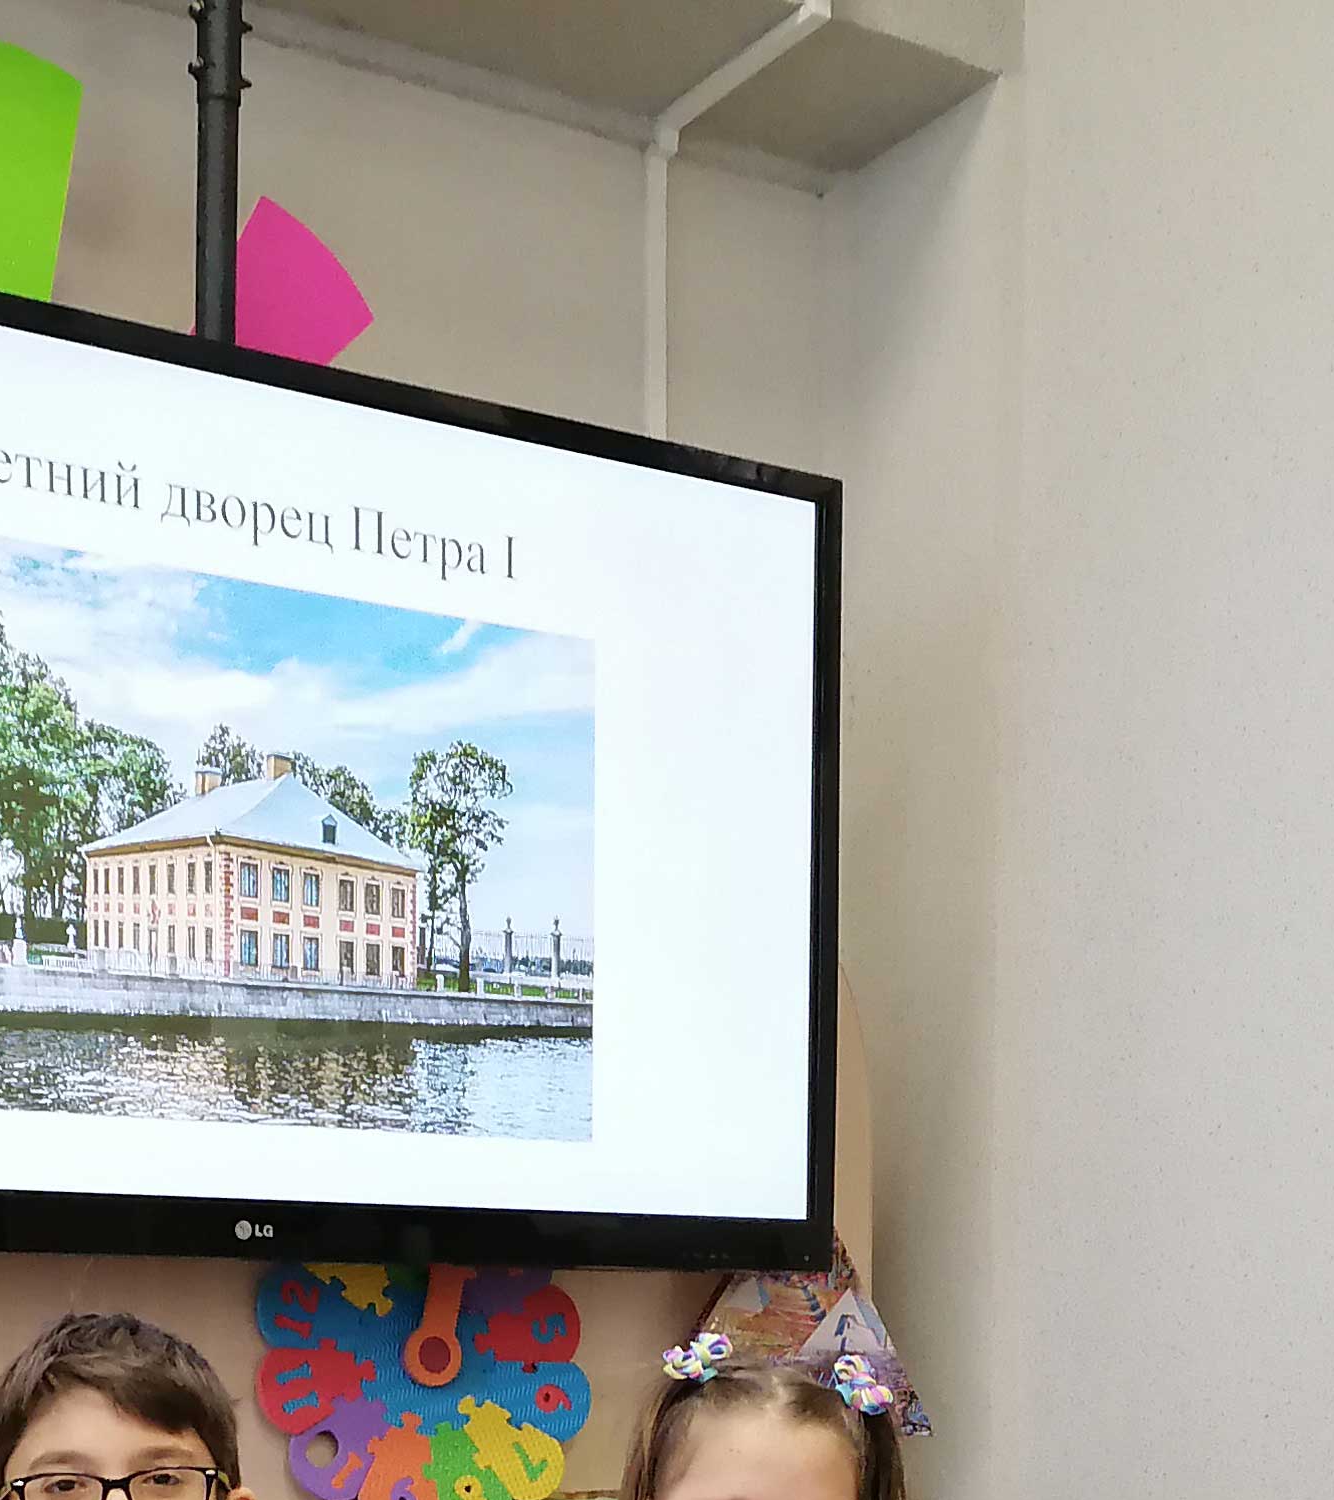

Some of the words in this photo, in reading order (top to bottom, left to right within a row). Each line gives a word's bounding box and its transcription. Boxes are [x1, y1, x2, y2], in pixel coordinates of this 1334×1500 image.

[160, 482, 334, 554] дворец
[352, 504, 487, 581] Петра
[254, 1223, 274, 1238] LG
